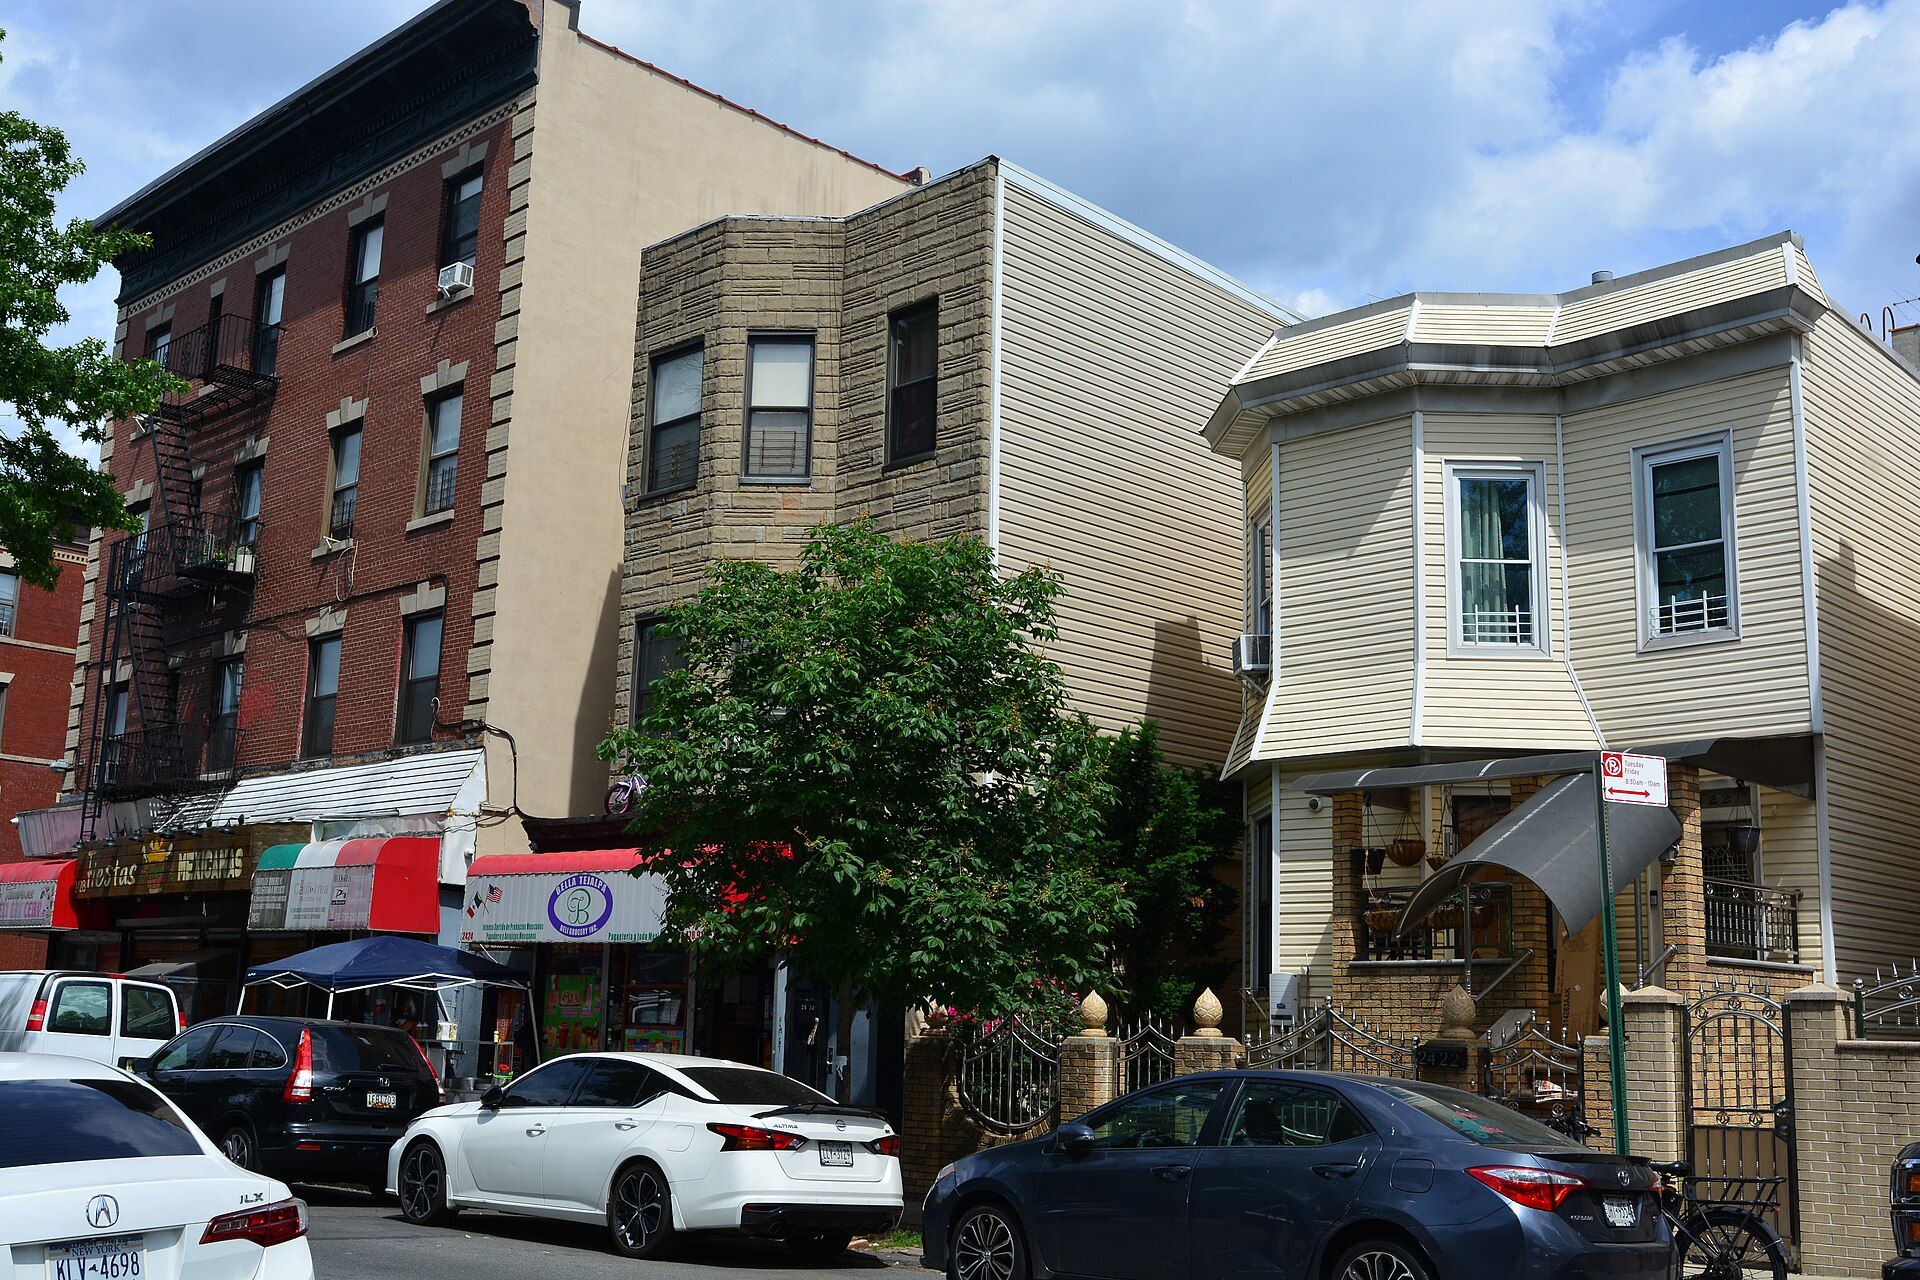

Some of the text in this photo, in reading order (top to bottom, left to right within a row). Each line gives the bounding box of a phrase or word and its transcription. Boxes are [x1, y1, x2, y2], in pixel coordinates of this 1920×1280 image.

[87, 848, 244, 888] Fiestas MEXICANAS
[555, 876, 607, 895] BELLA TEJALPA
[462, 931, 474, 940] 2424
[71, 1247, 93, 1257] NEW
[94, 1243, 121, 1254] YORK
